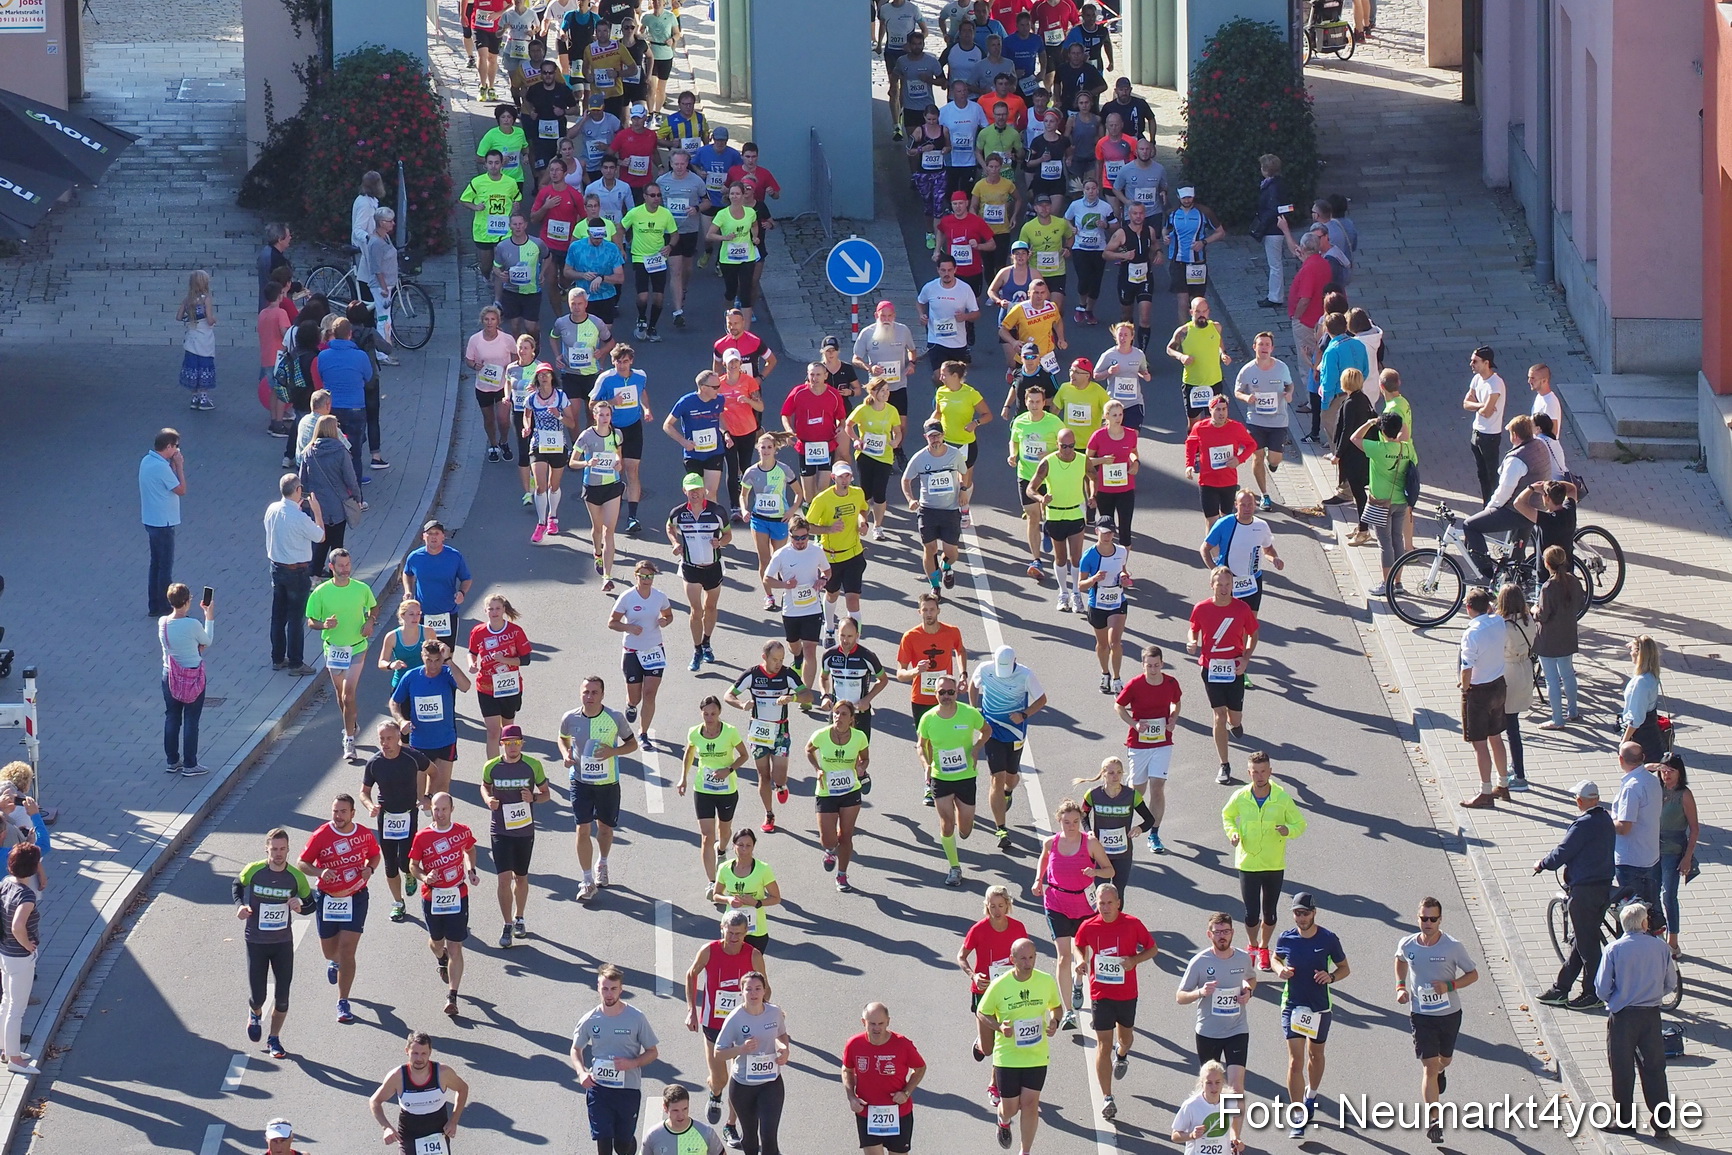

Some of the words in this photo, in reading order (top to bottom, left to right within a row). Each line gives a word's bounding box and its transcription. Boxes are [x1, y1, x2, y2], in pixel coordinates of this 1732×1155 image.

[955, 137, 971, 145] 2271
[633, 160, 646, 168] 355
[711, 177, 723, 185] 165
[669, 202, 686, 211] 2218
[489, 220, 506, 229] 2189
[552, 225, 565, 233] 162
[730, 247, 746, 255] 2295
[646, 255, 663, 264] 2292
[1042, 256, 1055, 264] 223
[1134, 268, 1142, 276] 41
[1190, 269, 1203, 277] 332
[936, 322, 954, 331] 2272
[1027, 317, 1042, 326] MAX
[571, 352, 589, 361] 2894
[484, 368, 497, 377] 254
[1118, 382, 1135, 391] 3002
[1193, 390, 1210, 399] 2633
[1257, 397, 1275, 406] 2547
[1072, 409, 1085, 418] 291
[546, 437, 556, 445] 93
[698, 434, 712, 444] 317
[866, 438, 884, 448] 2550
[808, 447, 825, 456] 2451
[1213, 451, 1231, 460] 2310
[1109, 469, 1123, 478] 146
[930, 476, 950, 487] 2159
[758, 499, 777, 509] 3140
[1234, 578, 1253, 589] 2654
[797, 588, 812, 598] 329
[1100, 592, 1118, 602] 2498
[427, 618, 447, 628] 2024
[330, 649, 350, 660] 3103
[641, 651, 661, 663] 2475
[1212, 664, 1232, 673] 2615
[496, 677, 516, 689] 2225
[418, 702, 439, 712] 2055
[755, 726, 770, 737] 298
[942, 754, 963, 765] 2164
[584, 762, 604, 772] 2891
[493, 778, 531, 789] BOCK
[830, 776, 851, 787] 2300
[510, 808, 526, 819] 346
[1094, 804, 1131, 815] BOCK
[387, 819, 406, 829] 2507
[1103, 834, 1123, 845] 2534
[253, 884, 292, 899] BOCK
[436, 894, 456, 904] 2227
[327, 901, 348, 911] 2222
[264, 910, 285, 920] 2527
[1098, 962, 1120, 973] 2436
[720, 997, 737, 1008] 271
[1216, 995, 1238, 1006] 2379
[1300, 1014, 1312, 1025] 58
[1019, 1024, 1040, 1037] 2297
[751, 1061, 774, 1072] 3050
[597, 1066, 620, 1078] 2057
[872, 1113, 895, 1124] 2370
[423, 1141, 442, 1153] 194
[1200, 1143, 1223, 1155] 2262
